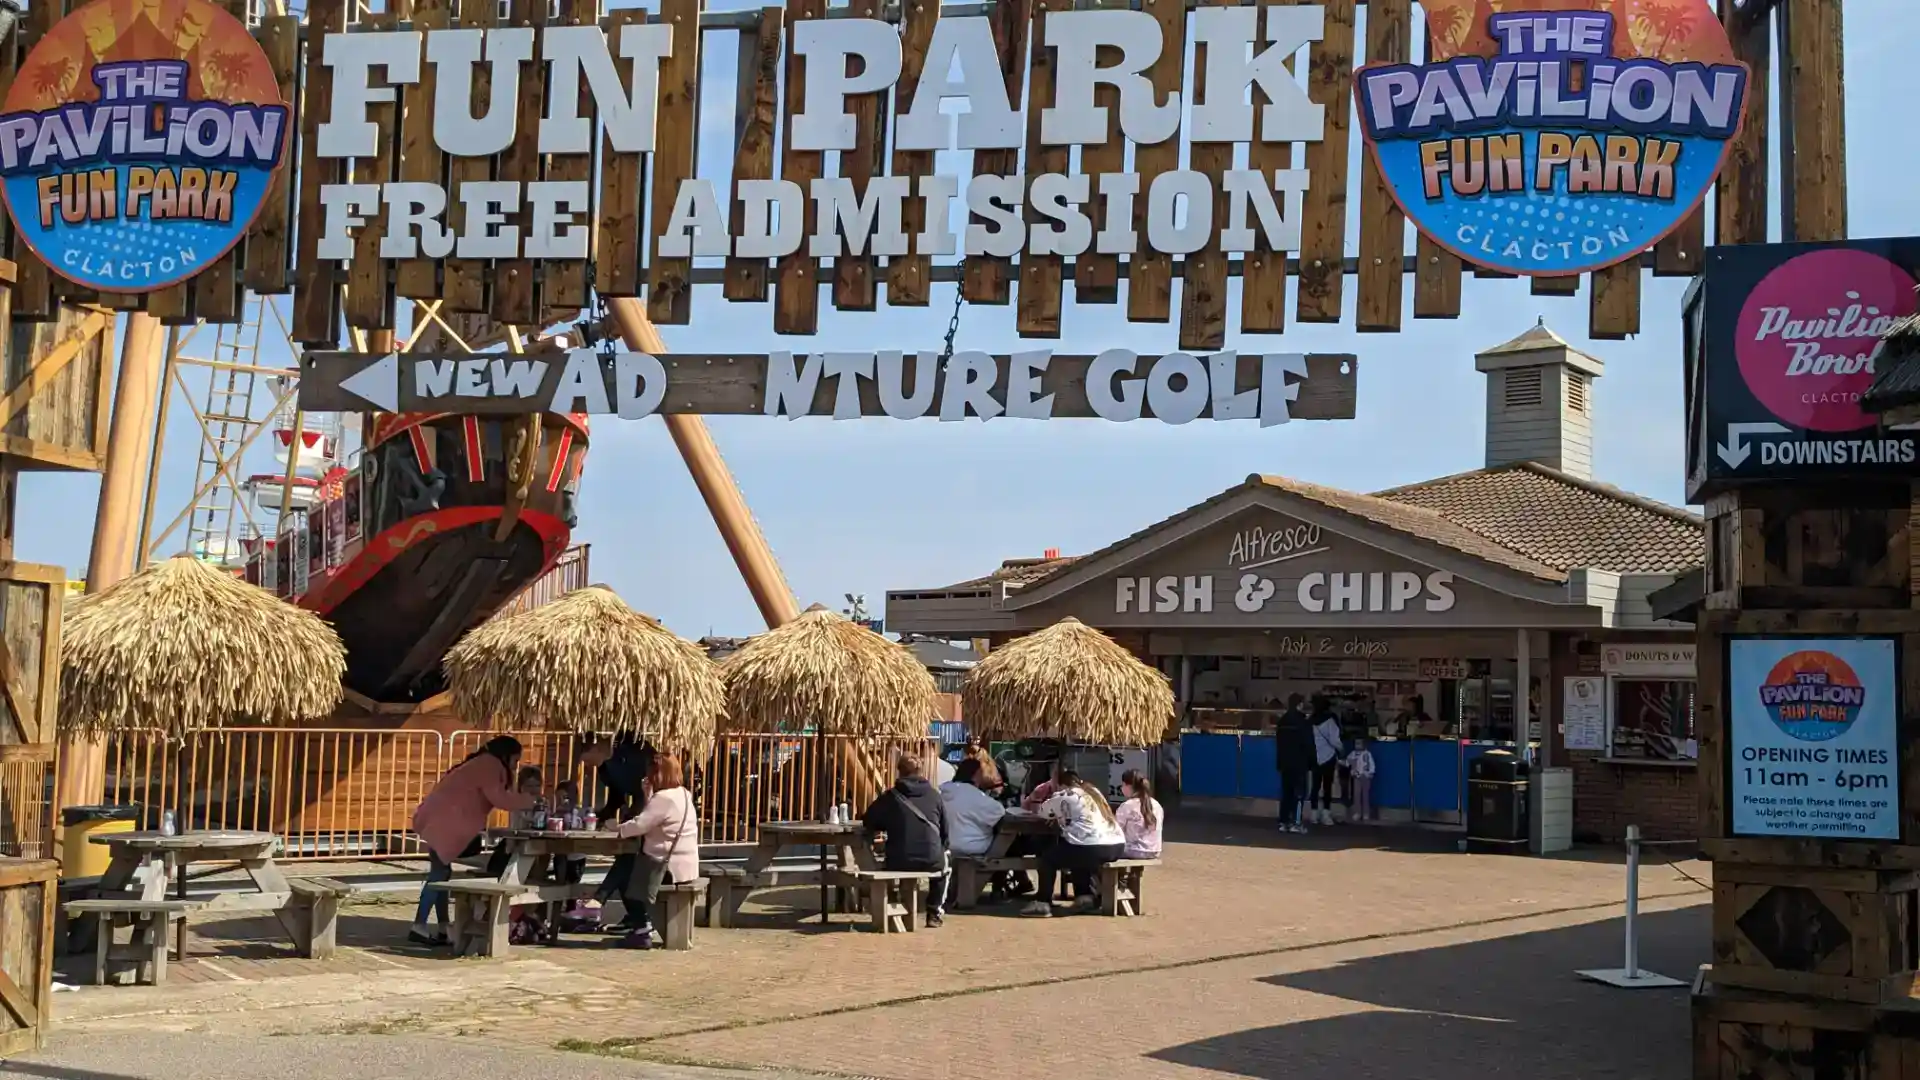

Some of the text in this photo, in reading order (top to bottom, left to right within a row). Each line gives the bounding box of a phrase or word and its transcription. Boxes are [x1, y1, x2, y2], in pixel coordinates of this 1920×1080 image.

[1497, 17, 1606, 53] THE
[98, 61, 182, 99] THE
[317, 5, 1325, 158] FUN PARK
[1420, 133, 1682, 199] FUN PARK
[39, 168, 238, 228] FUN PARK
[317, 169, 1310, 260] FREE ADMISSION
[1456, 224, 1630, 261] CLACTON
[63, 246, 197, 280] CLACTON
[1786, 341, 1886, 376] Bowl
[414, 358, 548, 399] NEW
[1086, 348, 1308, 428] GOLF
[1761, 440, 1915, 465] DOWNSTAIRS
[1228, 523, 1321, 566] Alfresco
[1115, 571, 1456, 613] FISH & CHIPS
[1280, 636, 1311, 655] fish
[1343, 636, 1390, 658] chips
[1625, 651, 1669, 661] DONUTS
[1423, 667, 1464, 677] COFFEE
[1796, 673, 1827, 684] THE
[1779, 704, 1847, 720] FUN PARK
[1742, 747, 1888, 764] OPENING TIMES
[1744, 768, 1808, 786] 11am
[1835, 770, 1888, 792] 6pm
[1744, 795, 1888, 808] Please note these times are
[1755, 808, 1876, 820] subject to change and
[1765, 821, 1866, 833] weather permitting
